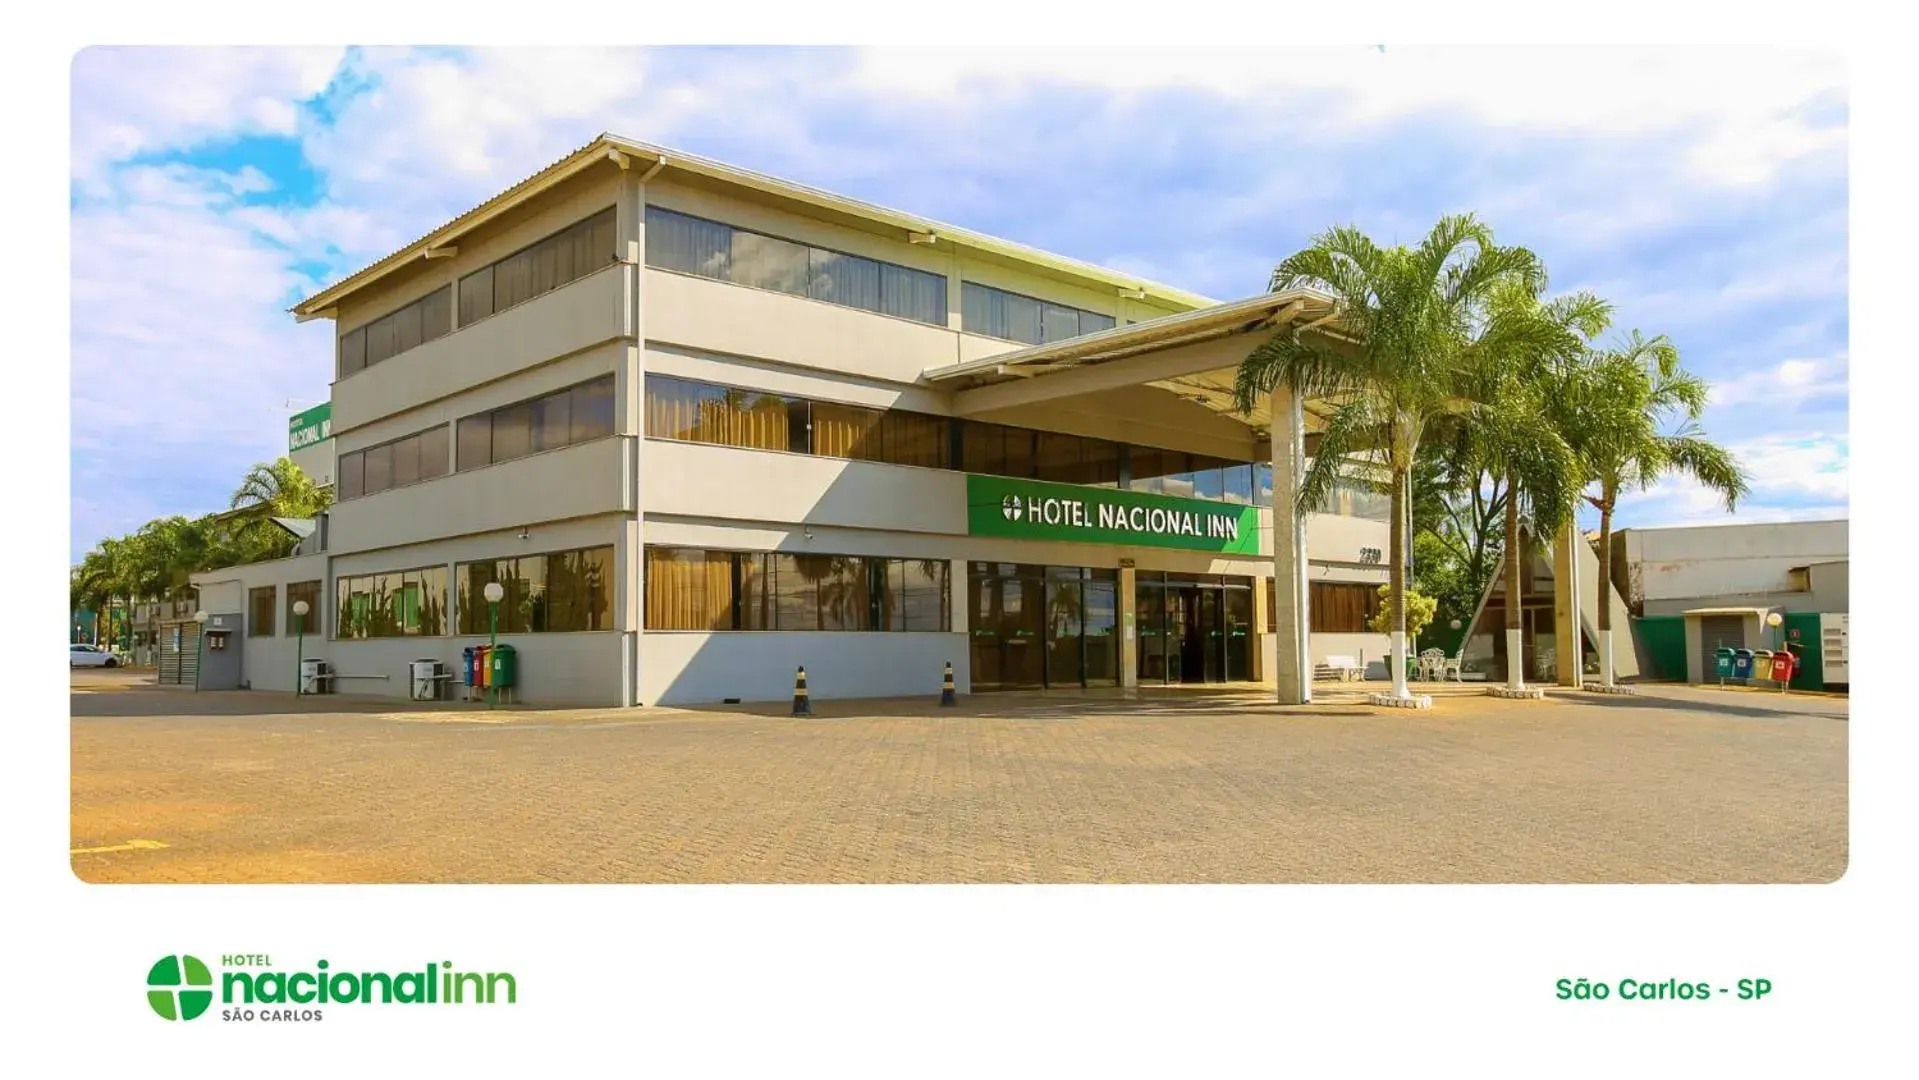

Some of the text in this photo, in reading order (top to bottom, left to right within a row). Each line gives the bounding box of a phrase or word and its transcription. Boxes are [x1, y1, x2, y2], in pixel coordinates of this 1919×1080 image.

[1028, 496, 1238, 540] HOTEL NACIONAL INN
